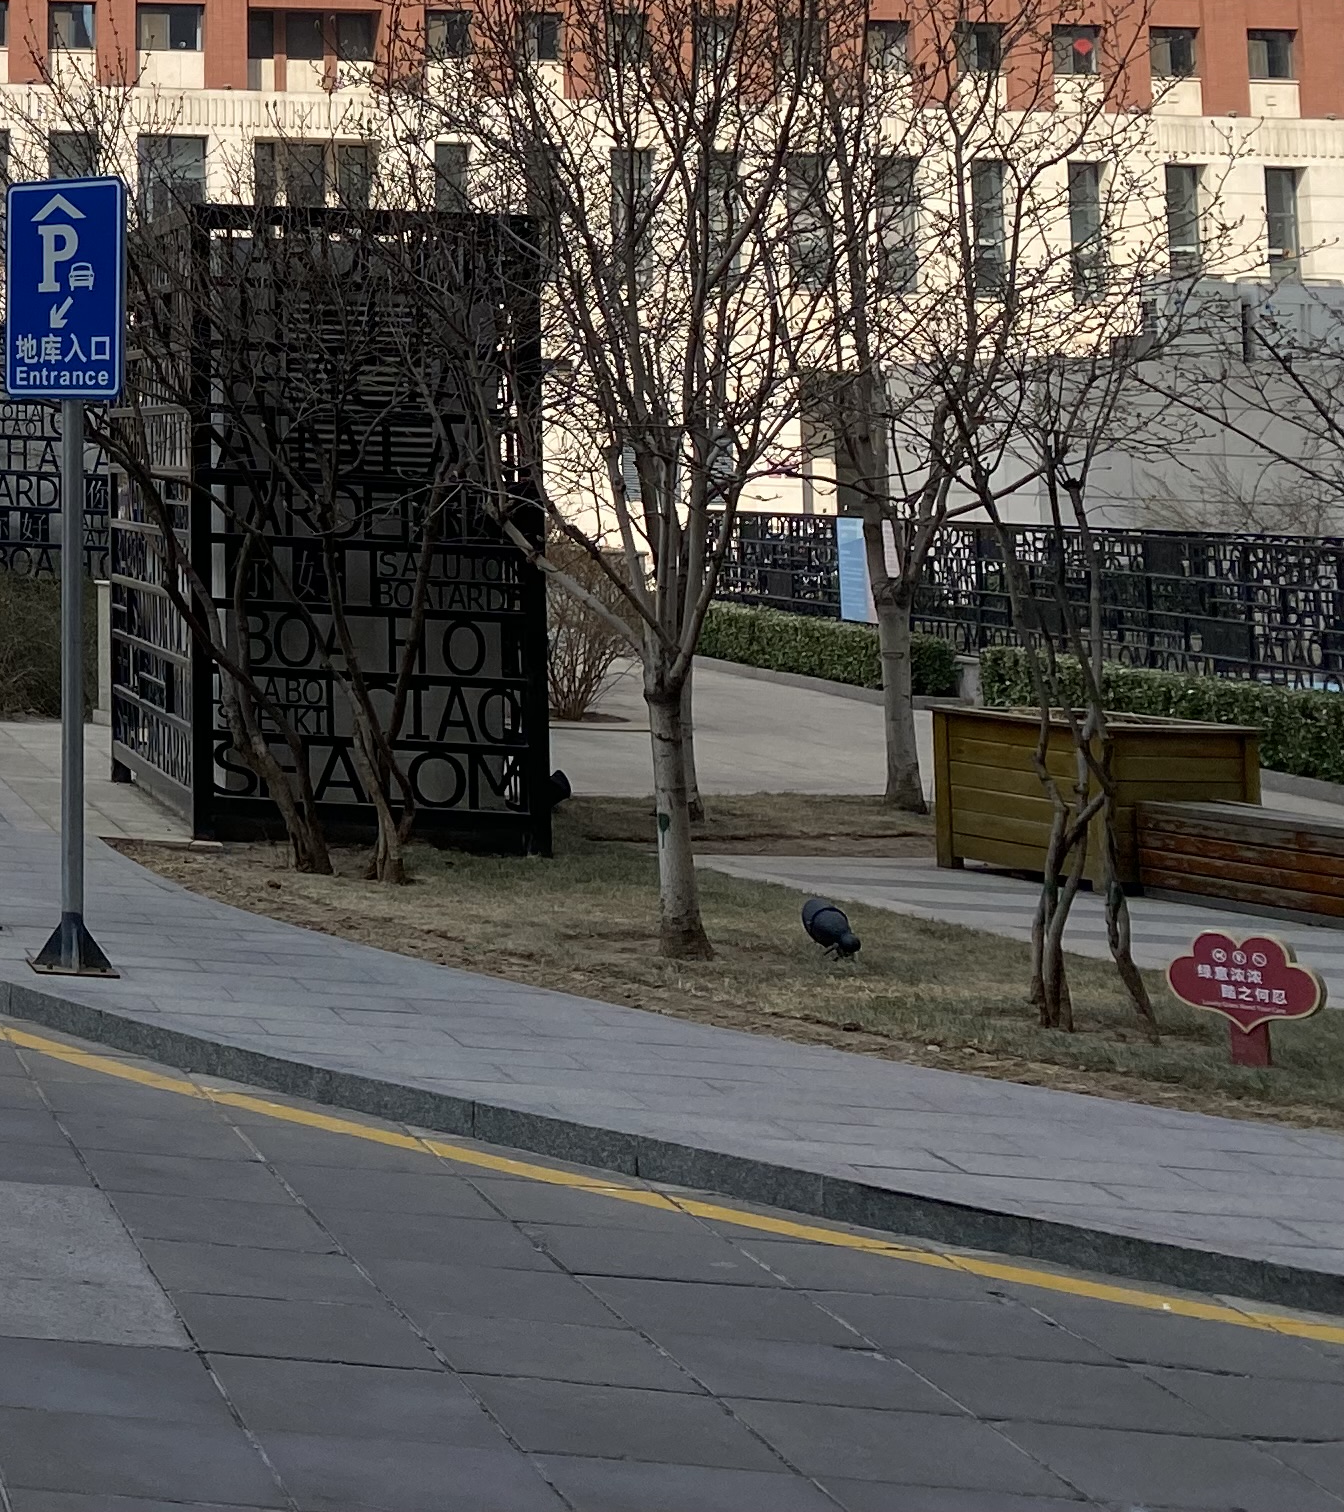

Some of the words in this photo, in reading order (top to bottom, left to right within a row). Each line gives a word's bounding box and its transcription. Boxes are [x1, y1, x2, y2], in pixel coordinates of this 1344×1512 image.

[37, 224, 79, 293] P
[15, 333, 110, 364] 地库入口
[15, 366, 109, 386] Entrance
